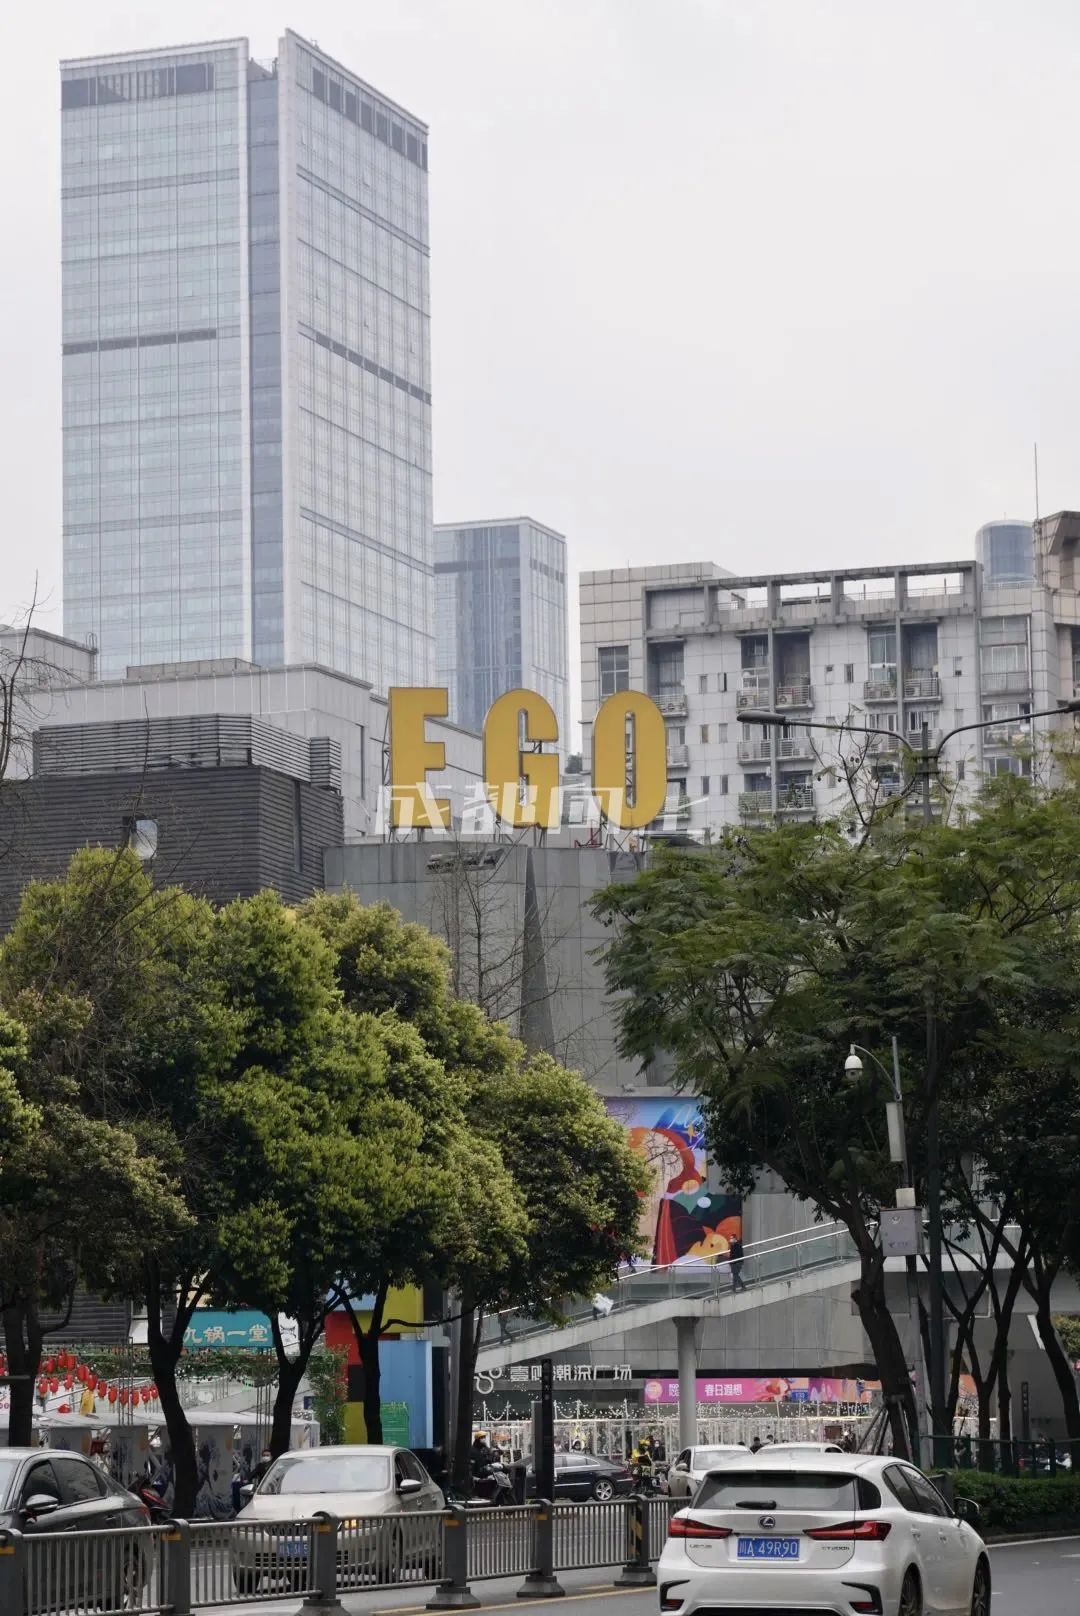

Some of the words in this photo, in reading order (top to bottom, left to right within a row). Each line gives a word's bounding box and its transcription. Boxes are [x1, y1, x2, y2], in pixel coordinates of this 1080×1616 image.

[388, 687, 668, 829] EGO
[183, 1324, 268, 1343] 九锅一堂
